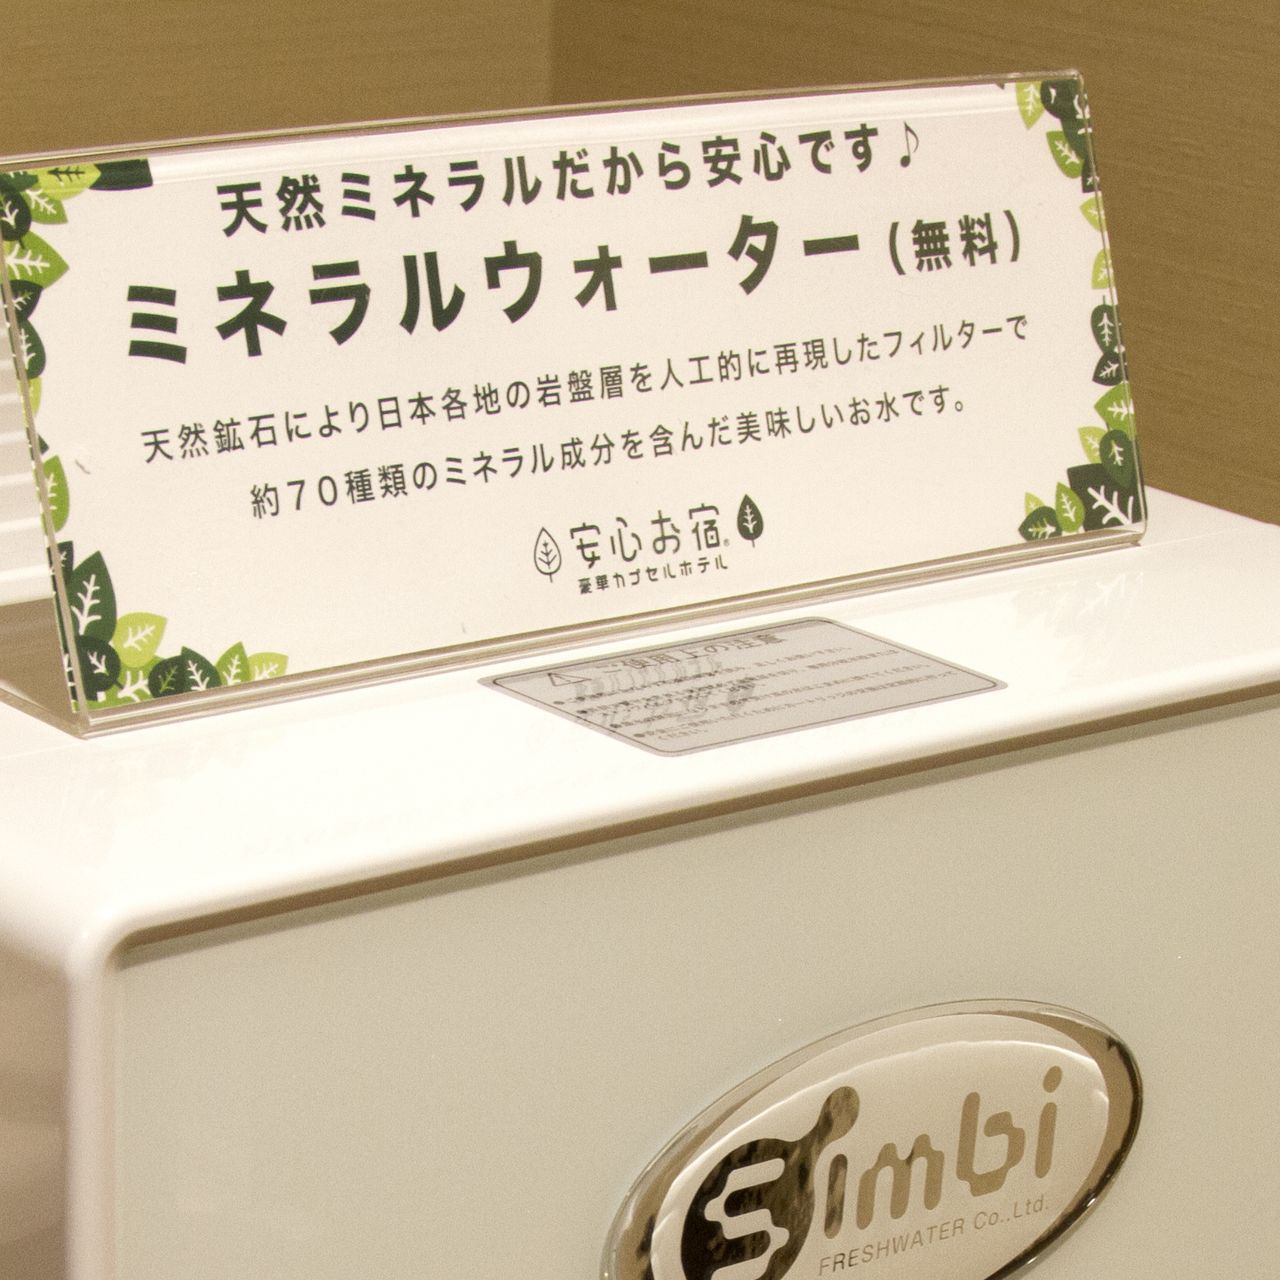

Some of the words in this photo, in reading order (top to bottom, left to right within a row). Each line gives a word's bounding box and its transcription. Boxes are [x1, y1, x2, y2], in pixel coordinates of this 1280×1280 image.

[141, 314, 1028, 464] 天然鉱石により日本各地の岩盤層を人工的に再現したフィルターで
[250, 384, 964, 519] 約70種類のミネラル成分を含んだ美味しいお水です。
[577, 553, 729, 595] 豪華カプセルホテル
[818, 1217, 966, 1276] FRESHWATER
